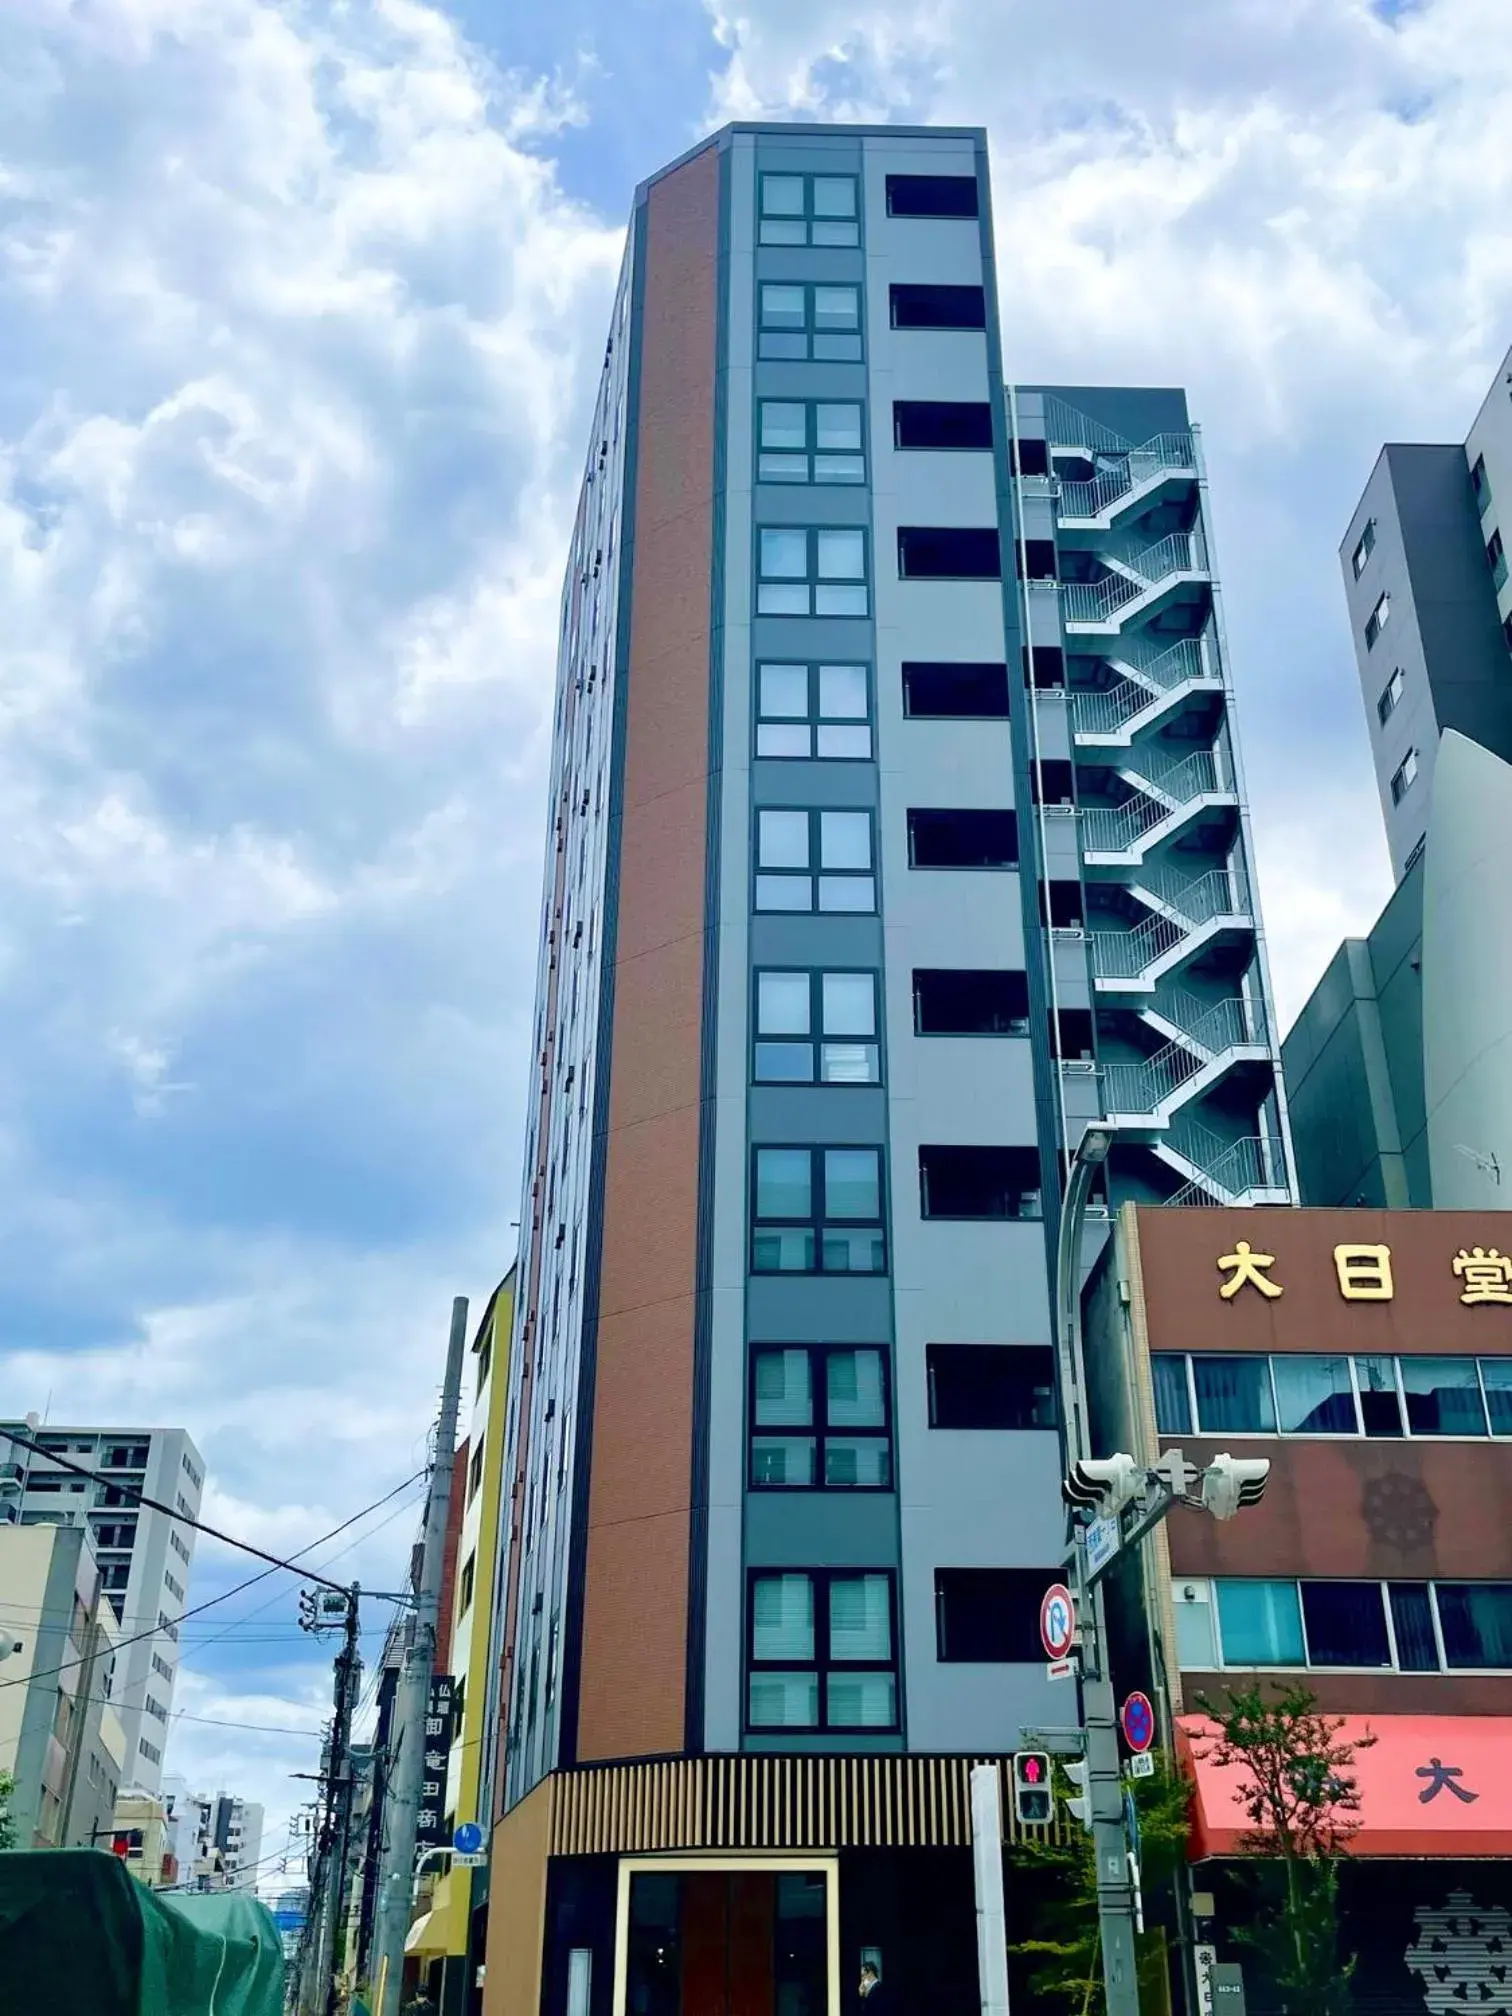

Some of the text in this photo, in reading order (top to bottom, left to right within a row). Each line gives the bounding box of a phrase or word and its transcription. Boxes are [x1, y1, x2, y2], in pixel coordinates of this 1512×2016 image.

[1217, 1240, 1512, 1305] 大日堂
[1415, 1757, 1479, 1803] 大
